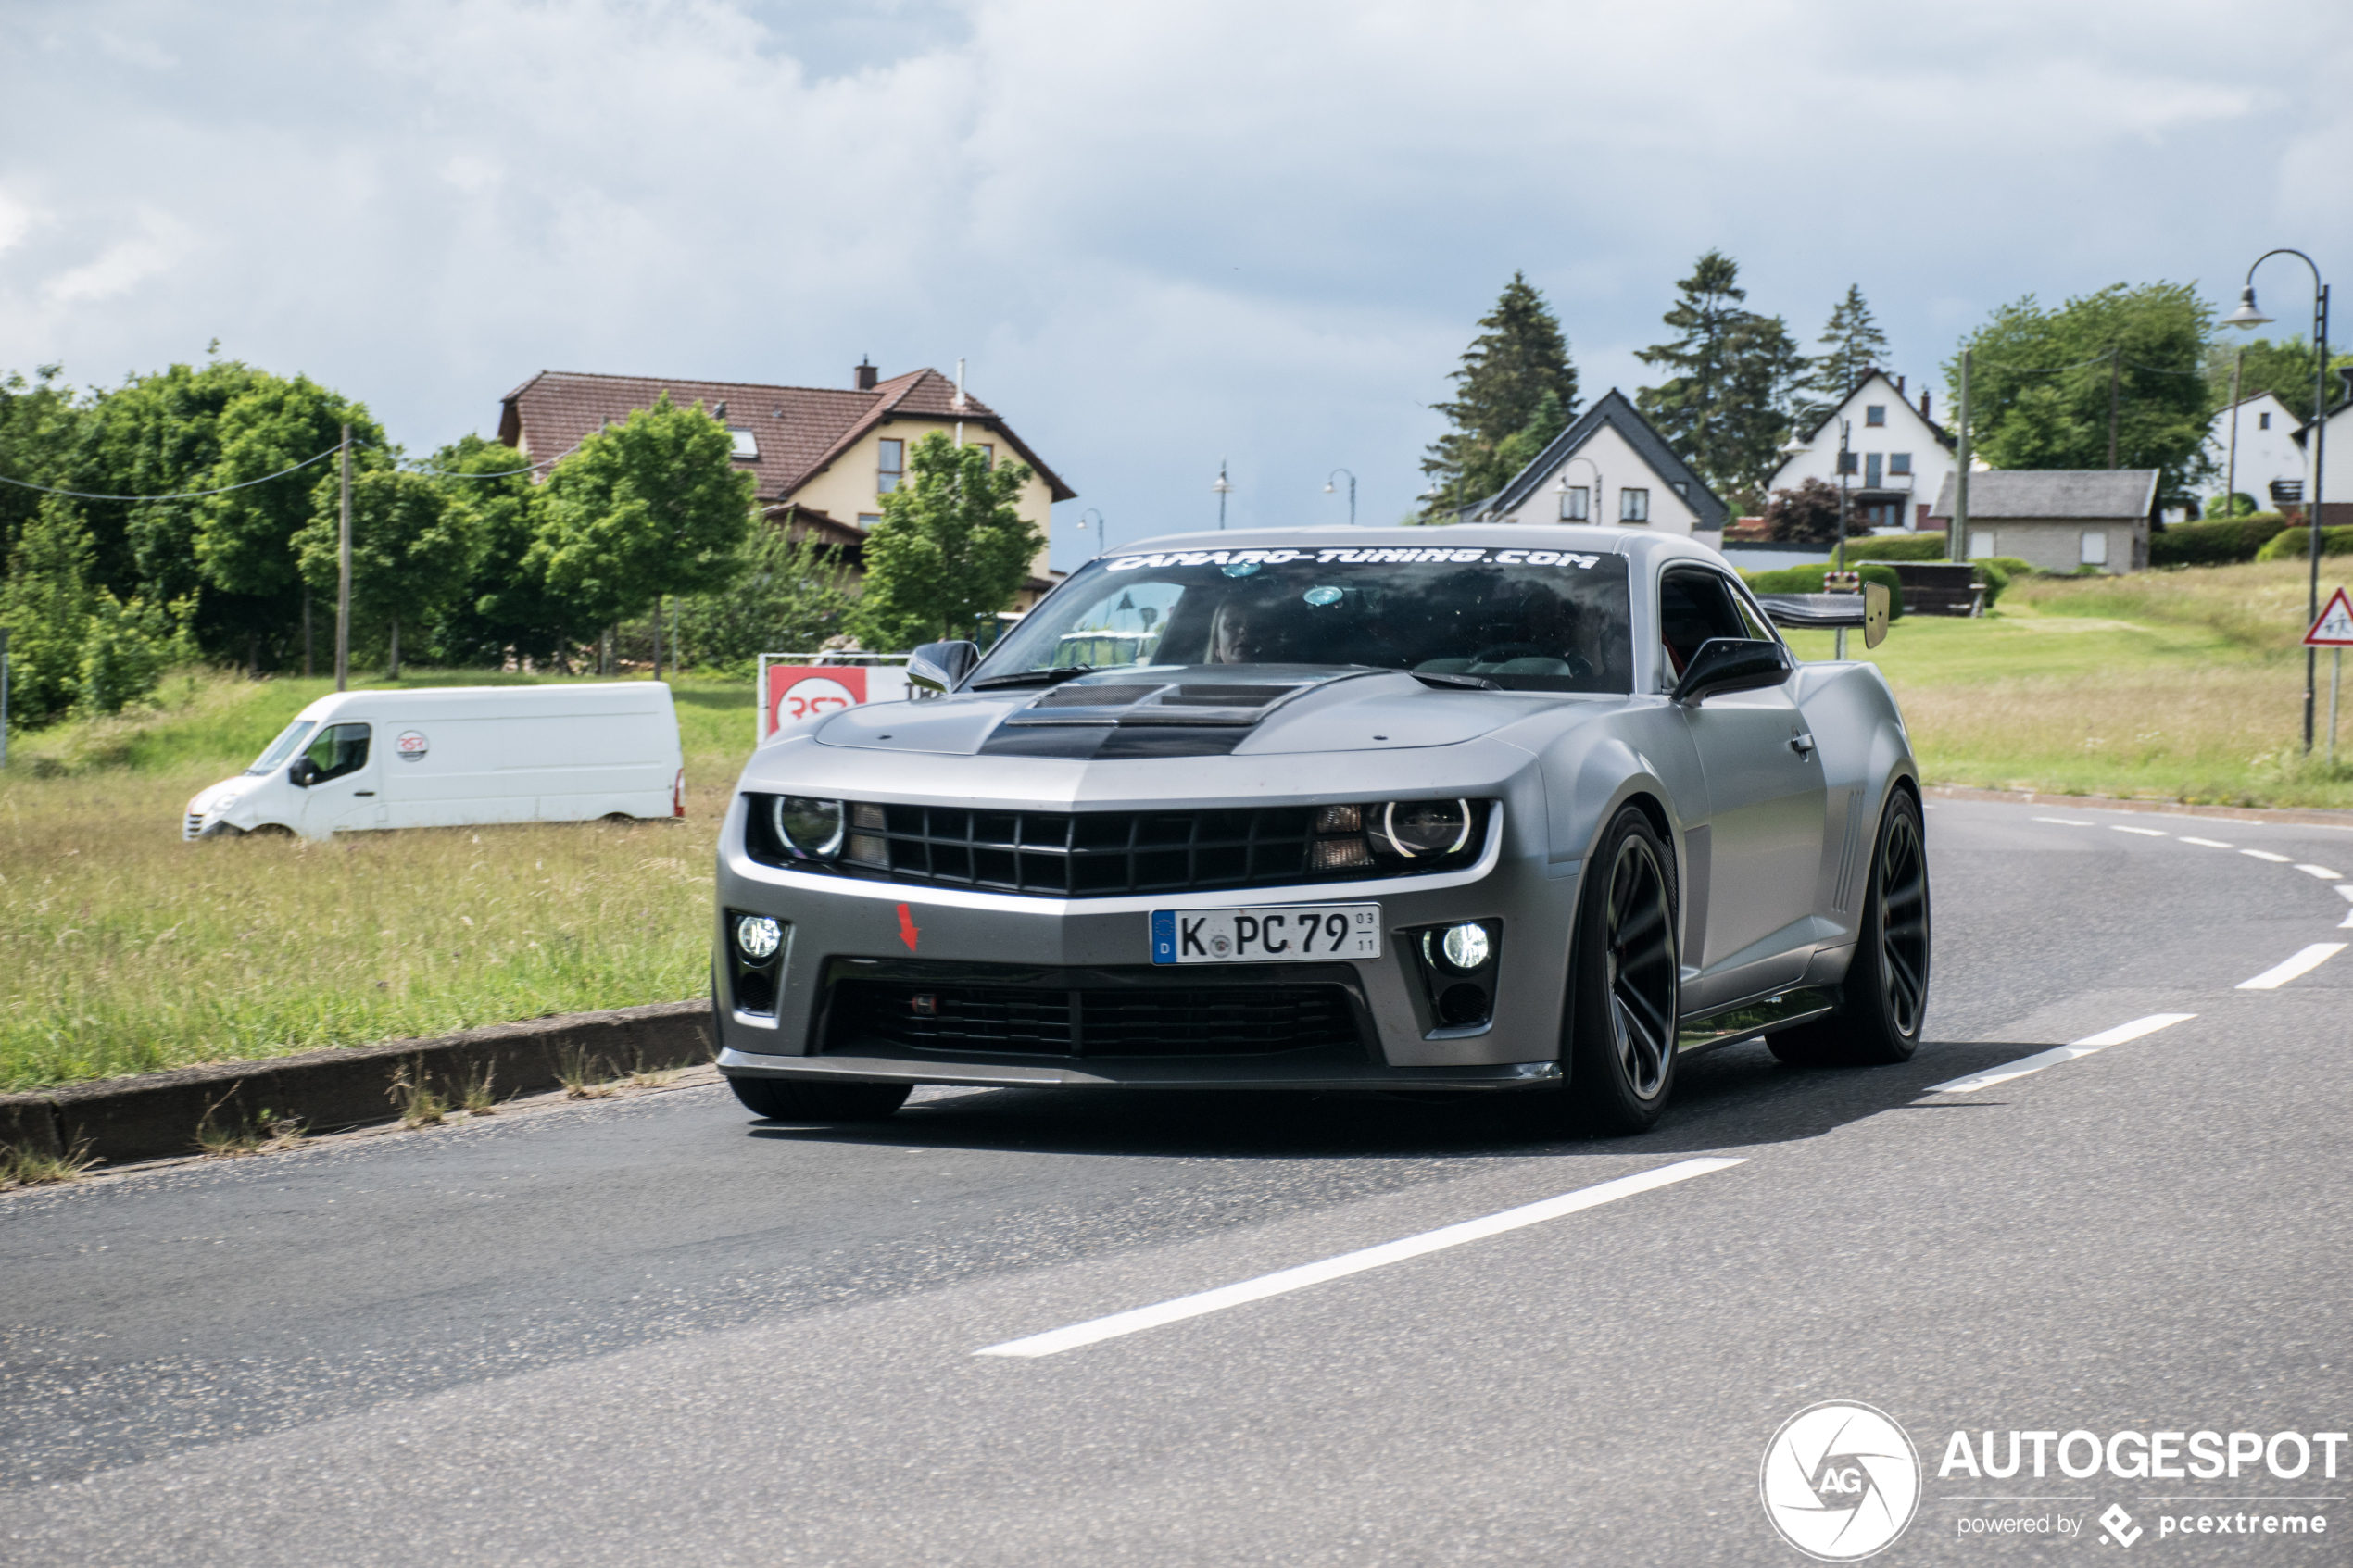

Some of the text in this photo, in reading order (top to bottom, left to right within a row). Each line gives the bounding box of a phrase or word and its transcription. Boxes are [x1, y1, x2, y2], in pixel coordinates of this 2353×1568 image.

[1106, 548, 1600, 571] CAMARO-TUNING.COM
[1356, 912, 1374, 924] 03
[1181, 913, 1349, 956] K PC 79
[1160, 943, 1170, 954] D
[1358, 939, 1374, 951] 11
